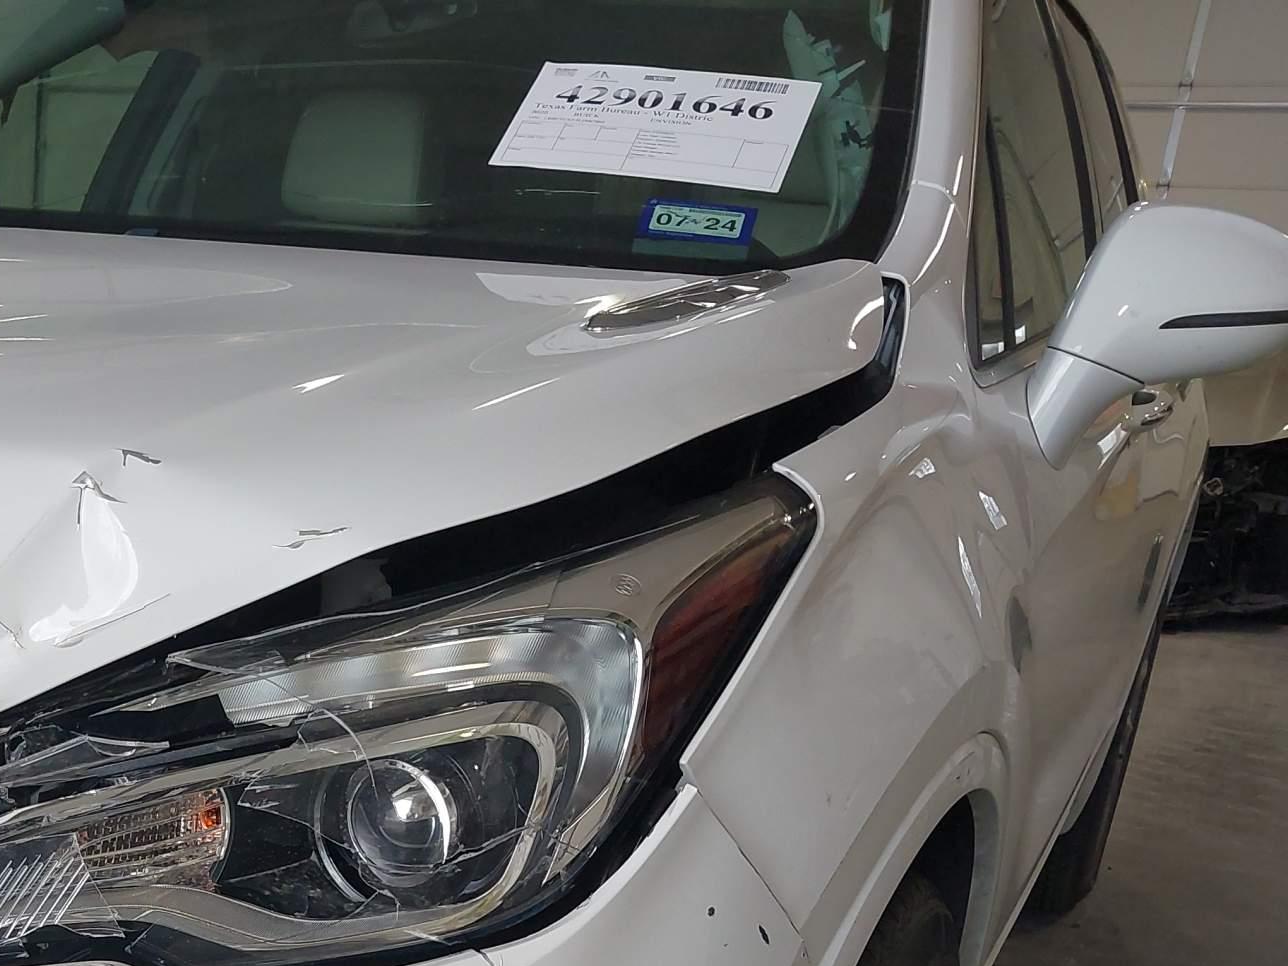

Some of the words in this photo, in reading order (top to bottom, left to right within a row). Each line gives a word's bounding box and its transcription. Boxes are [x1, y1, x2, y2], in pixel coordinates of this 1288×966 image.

[555, 84, 777, 120] 42901646
[569, 104, 598, 112] Farm
[601, 106, 641, 116] Bureau
[675, 112, 713, 122] Distric
[656, 212, 688, 227] 07
[703, 217, 737, 232] 24
